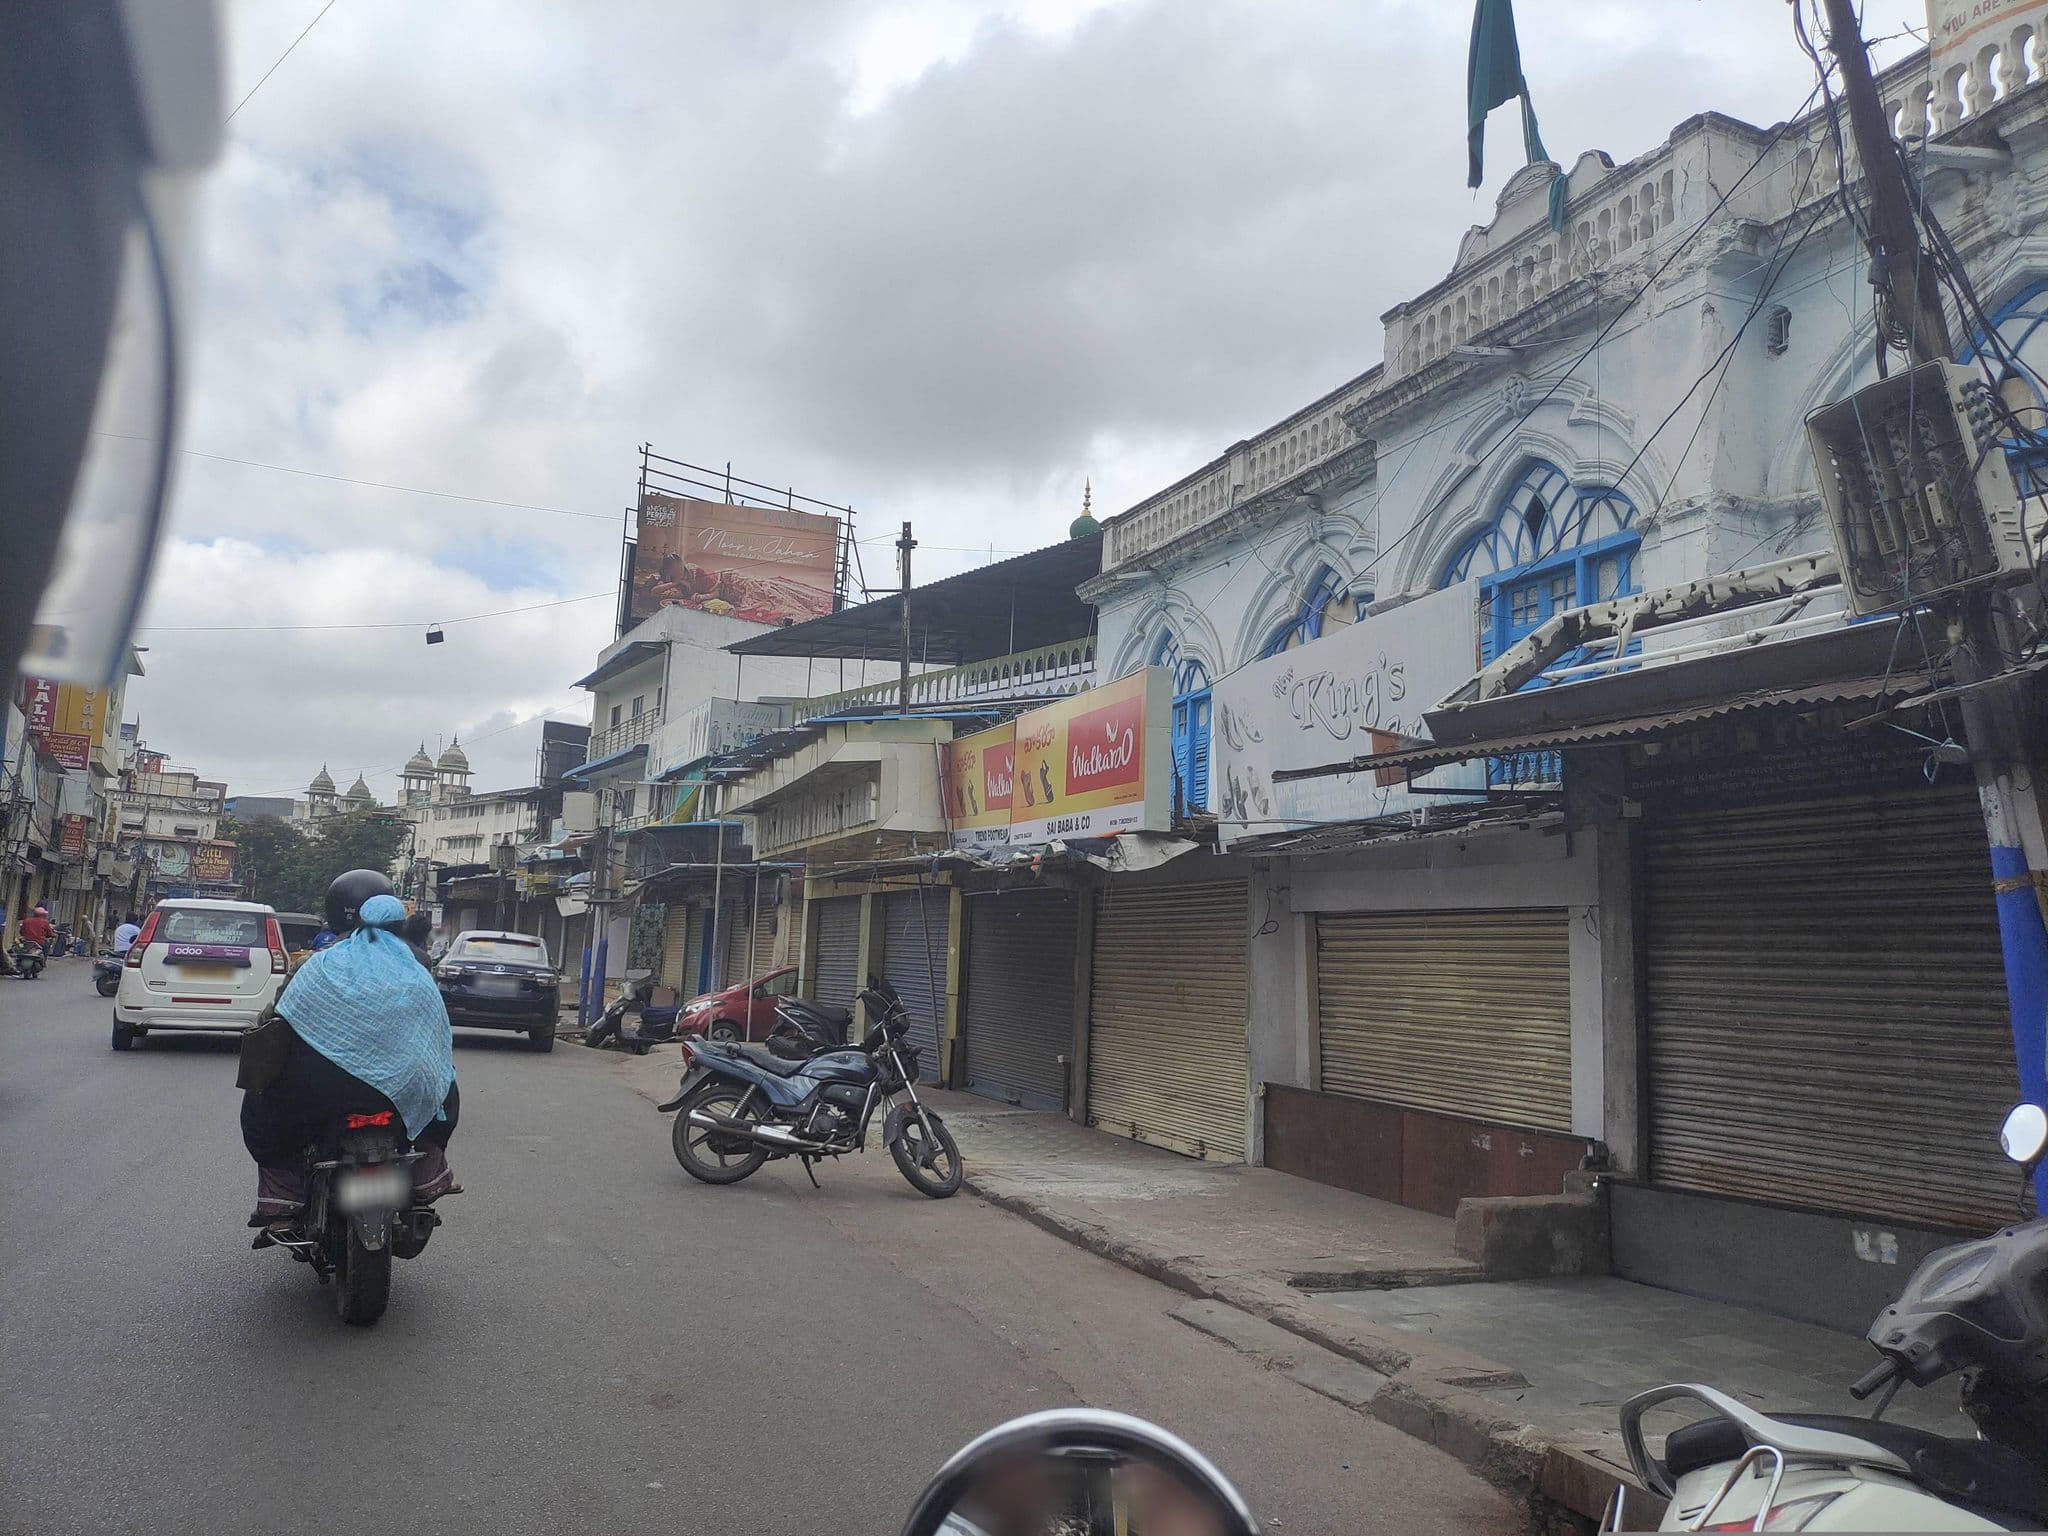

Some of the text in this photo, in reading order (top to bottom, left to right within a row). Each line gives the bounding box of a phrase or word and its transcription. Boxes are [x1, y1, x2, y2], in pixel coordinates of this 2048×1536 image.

[1290, 651, 1405, 741] King's
[1046, 815, 1090, 836] SAI BABA & CO
[174, 946, 203, 956] odoo
